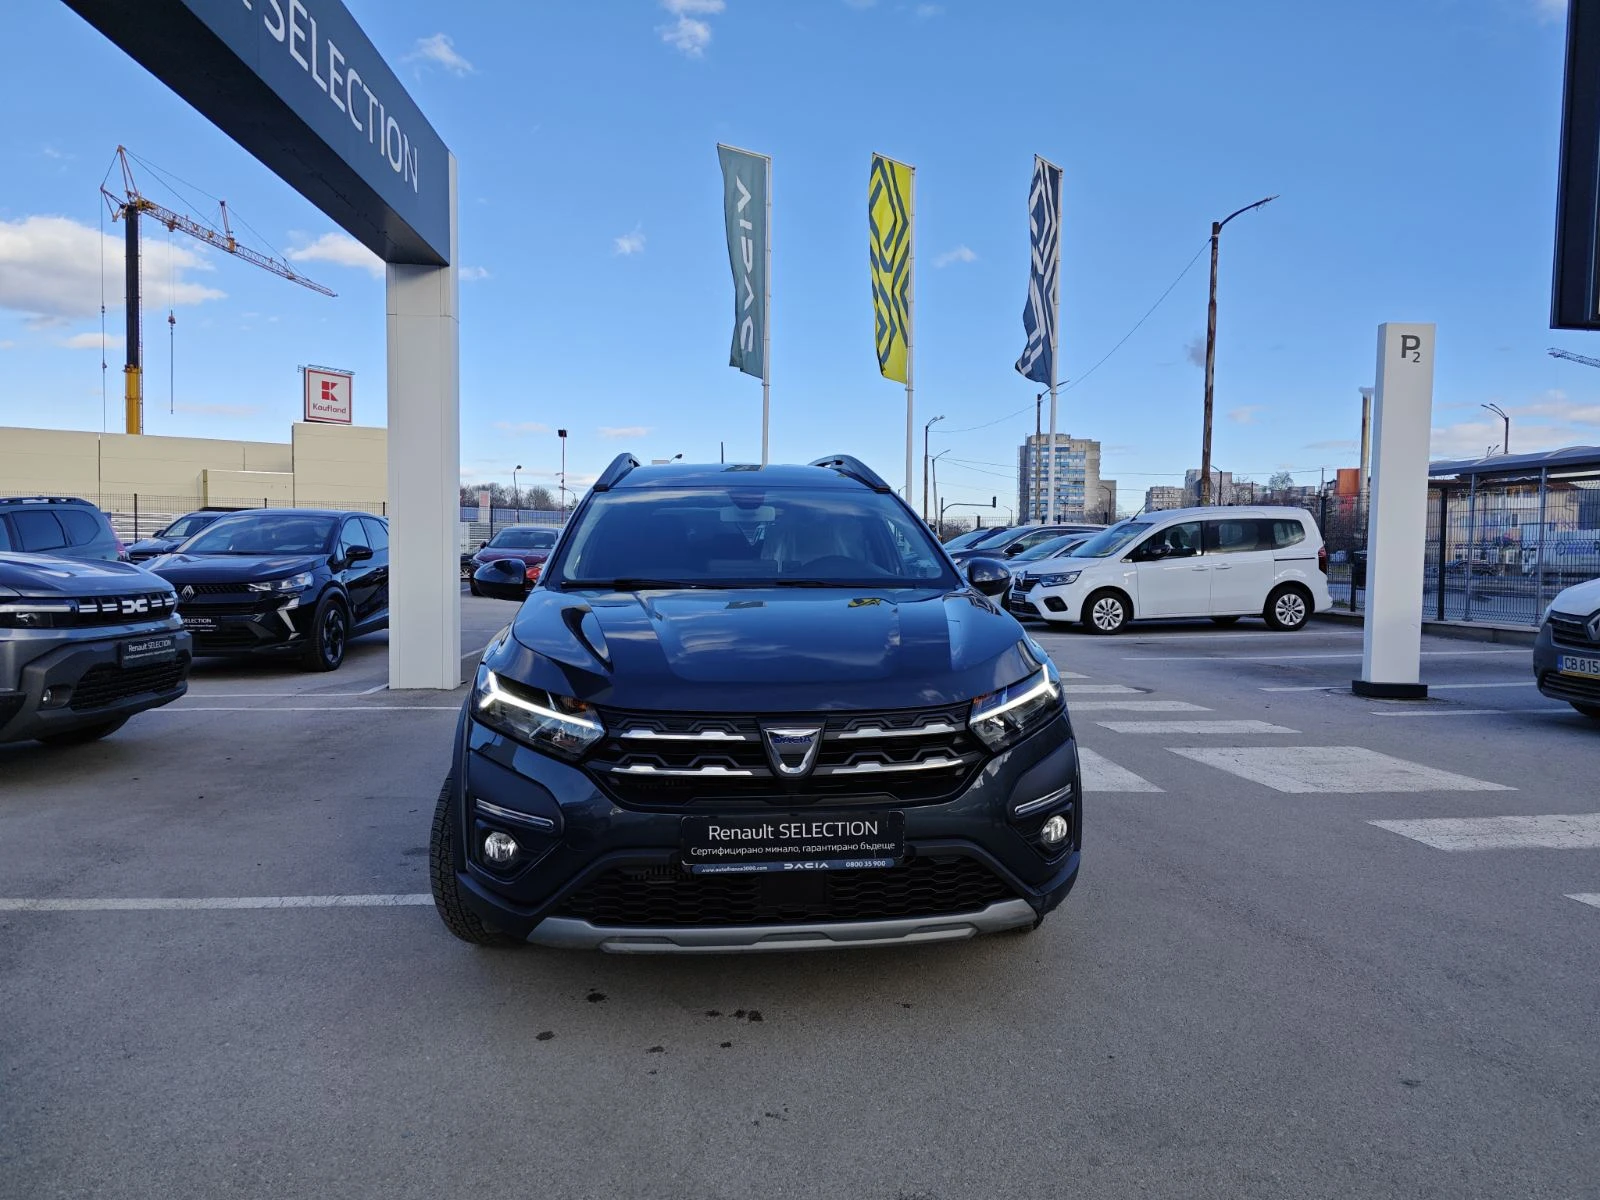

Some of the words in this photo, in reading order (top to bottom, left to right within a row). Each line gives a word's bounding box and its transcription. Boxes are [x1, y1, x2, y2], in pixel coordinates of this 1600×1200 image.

[264, 0, 418, 193] SELECTION
[312, 402, 347, 414] Kaufland
[128, 642, 148, 652] Renault
[148, 639, 172, 649] SELECTION
[1564, 657, 1578, 671] CB
[1580, 659, 1599, 673] 815
[708, 823, 775, 841] Renault
[779, 820, 878, 840] SELECTION
[690, 846, 764, 856] Сертифицирано
[765, 844, 801, 853] минало,
[802, 843, 859, 853] гарантирано
[860, 841, 896, 851] бъдеще
[783, 862, 829, 870] DACIA
